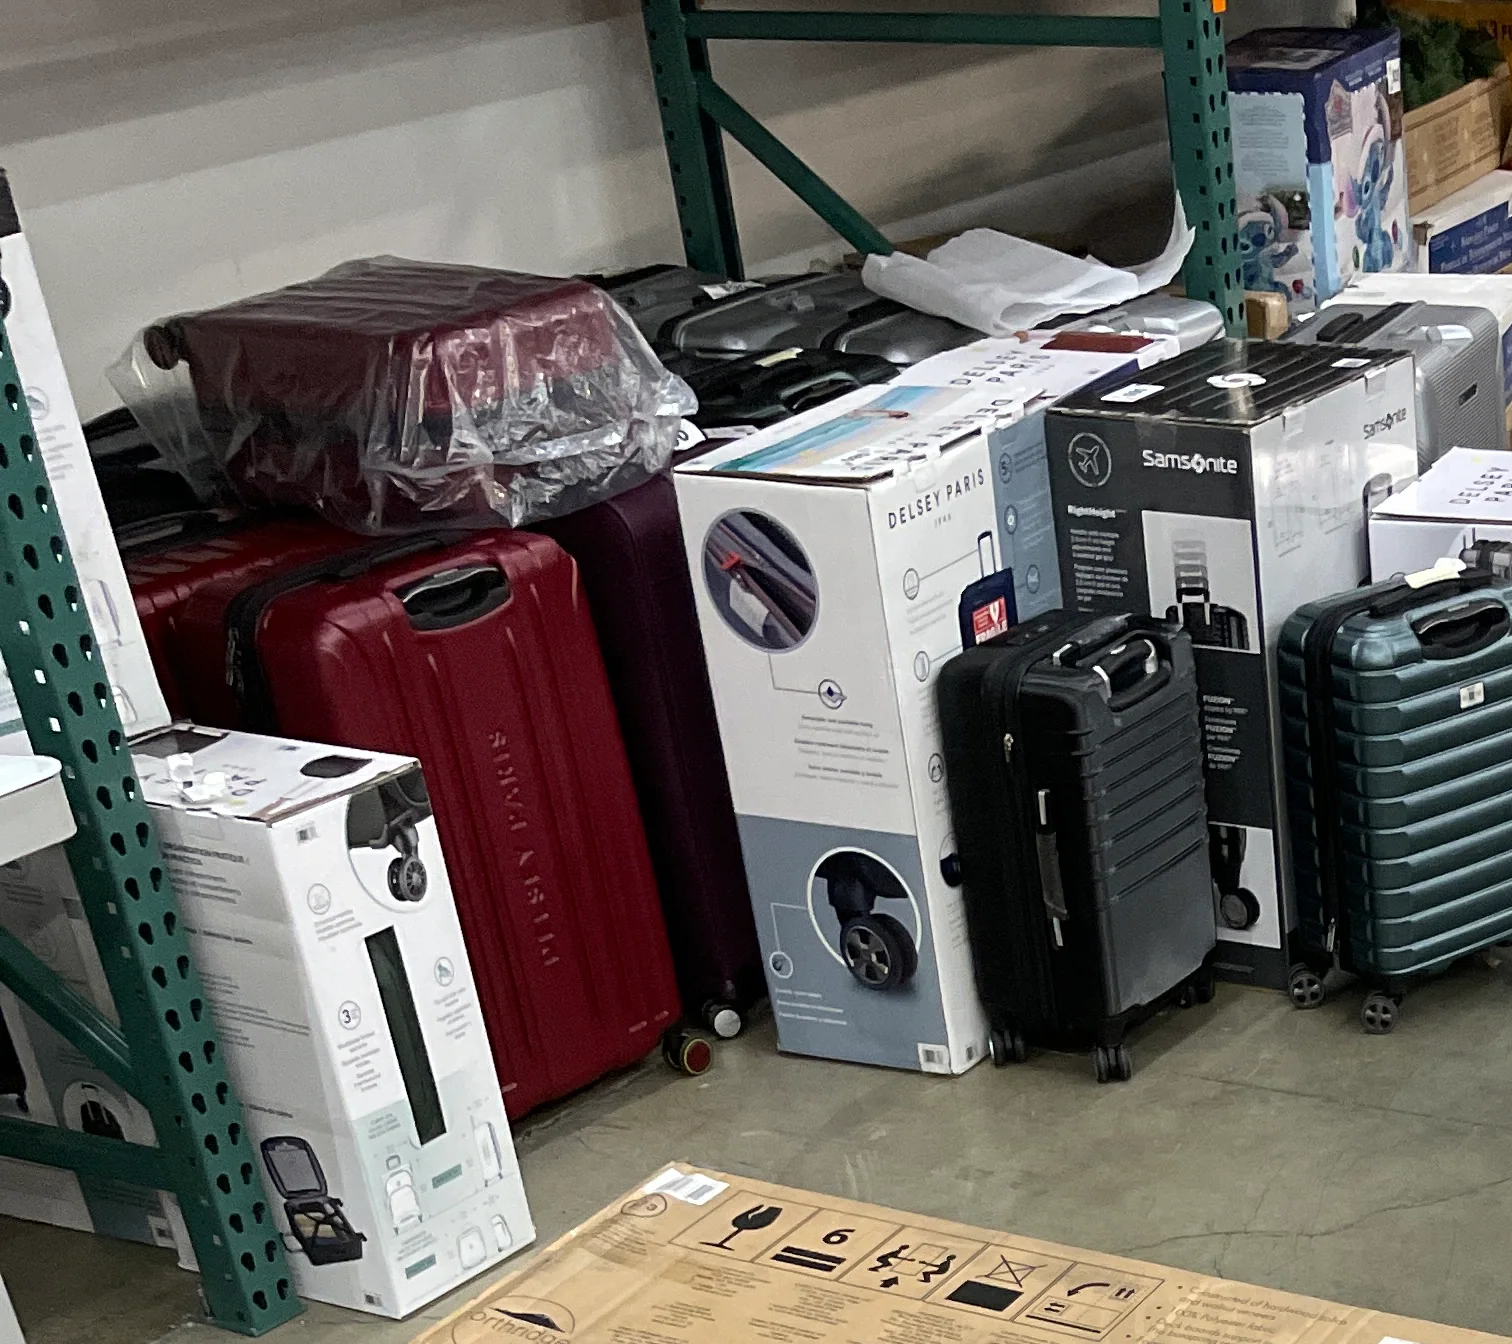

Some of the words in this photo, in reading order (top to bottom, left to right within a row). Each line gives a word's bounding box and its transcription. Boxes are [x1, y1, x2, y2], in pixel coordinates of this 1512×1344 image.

[1362, 407, 1407, 441] Samsonite
[1142, 449, 1238, 475] Samsonite
[888, 489, 942, 529] DELSEY
[946, 468, 985, 499] PARIS
[1449, 466, 1509, 505] DELSEY
[823, 1228, 855, 1245] 6
